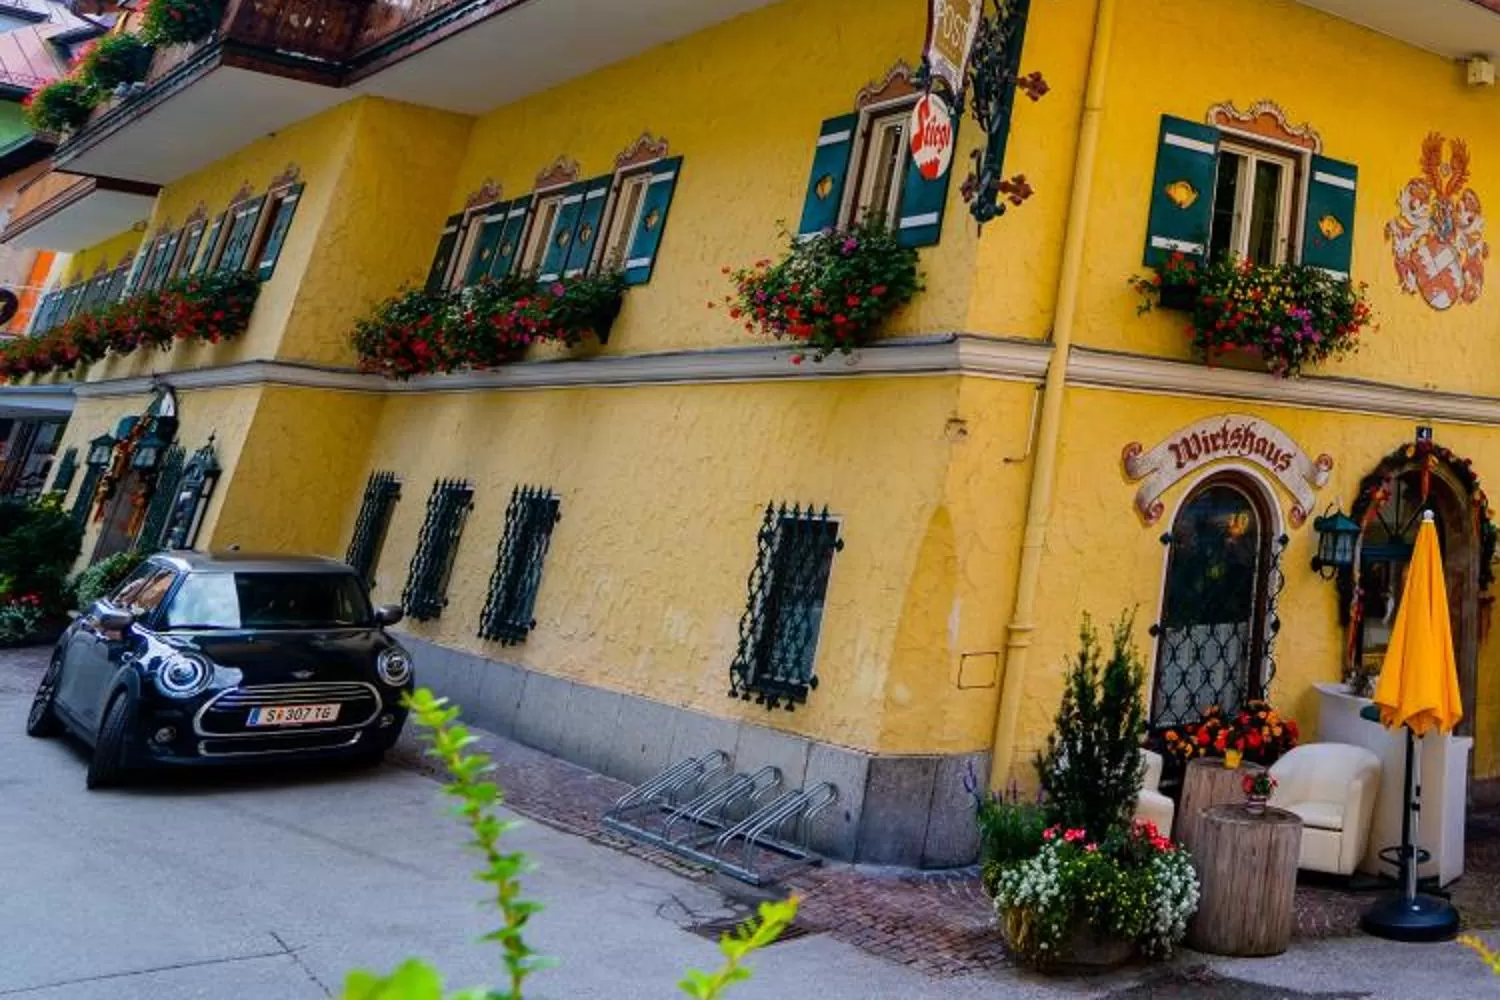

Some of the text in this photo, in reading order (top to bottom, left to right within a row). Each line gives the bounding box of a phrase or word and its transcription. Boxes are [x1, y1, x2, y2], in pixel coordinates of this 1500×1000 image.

[1168, 418, 1297, 472] Wirtshaus
[266, 708, 277, 722] S
[285, 707, 313, 721] 307
